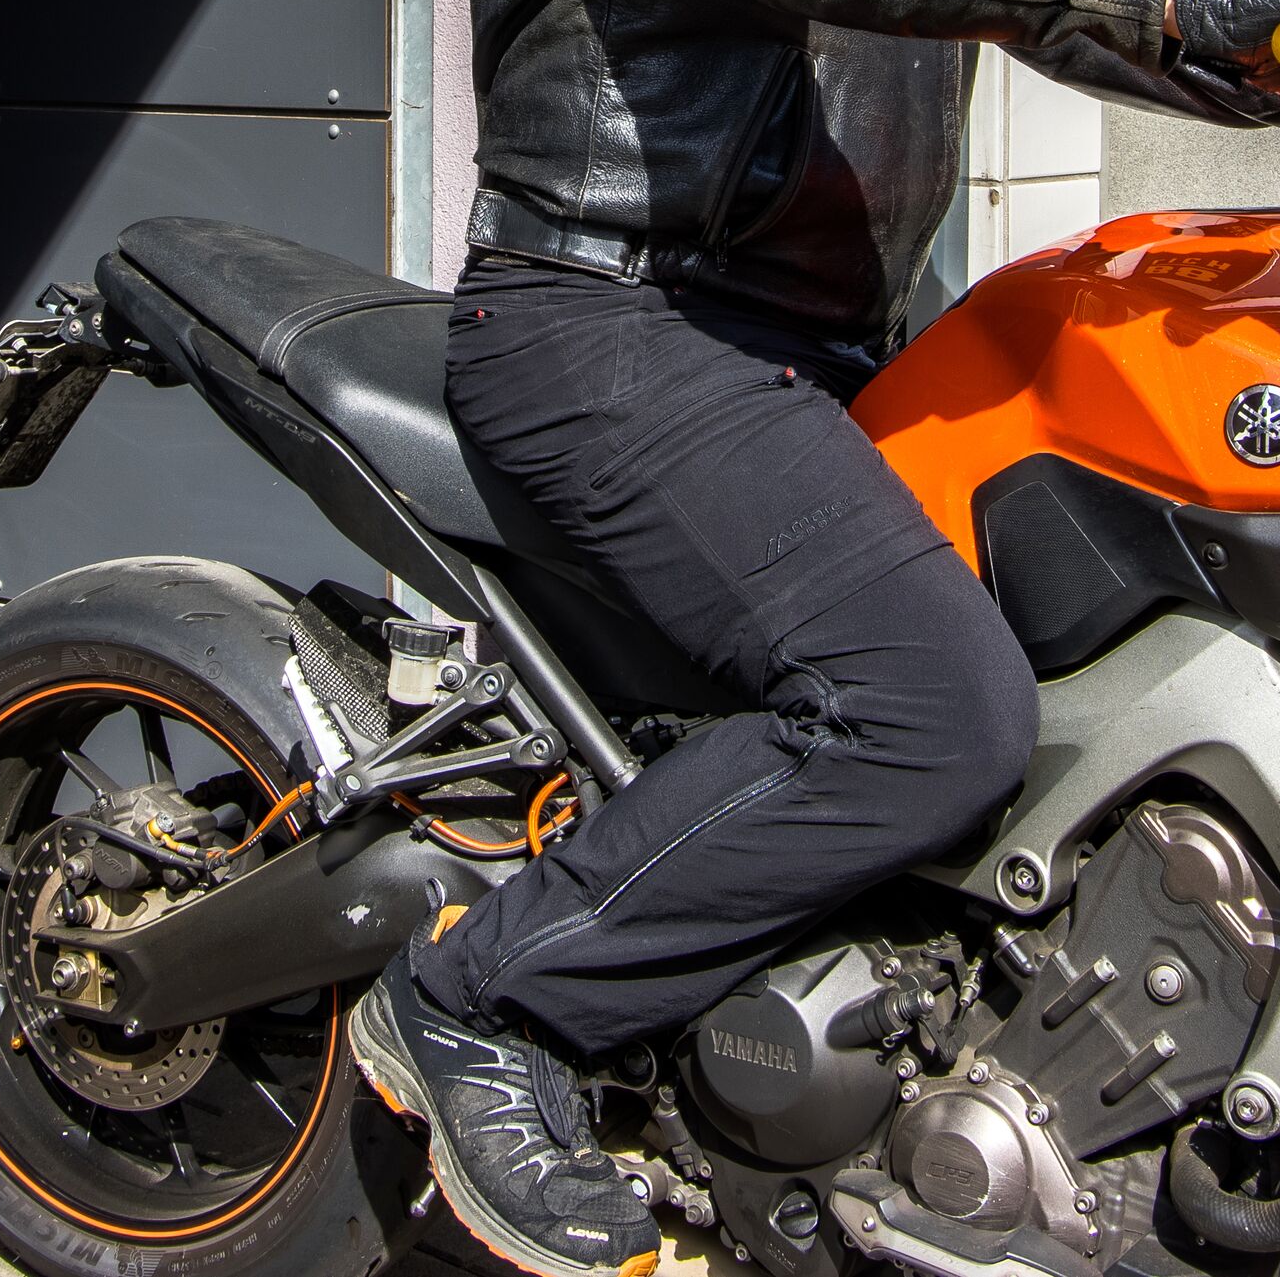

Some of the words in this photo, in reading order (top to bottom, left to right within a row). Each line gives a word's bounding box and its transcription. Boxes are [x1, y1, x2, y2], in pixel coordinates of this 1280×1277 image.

[423, 1030, 459, 1049] LOWA
[710, 1029, 798, 1073] YAMAHA
[566, 1226, 609, 1242] LOWA
